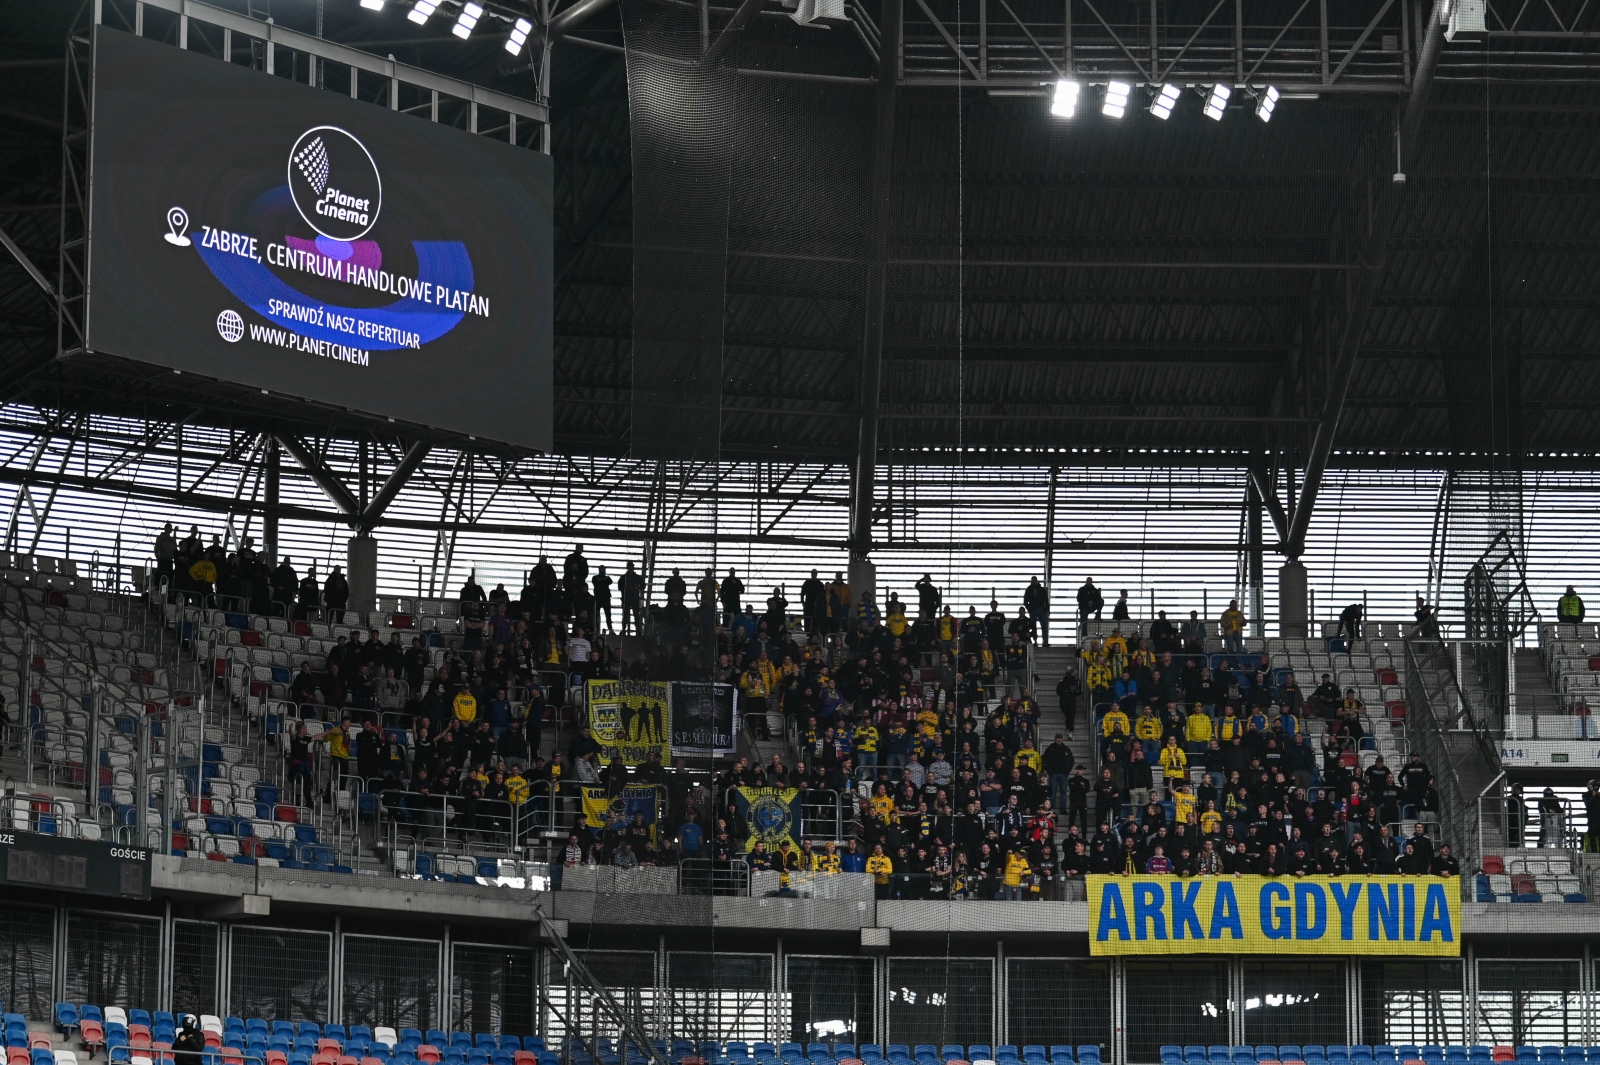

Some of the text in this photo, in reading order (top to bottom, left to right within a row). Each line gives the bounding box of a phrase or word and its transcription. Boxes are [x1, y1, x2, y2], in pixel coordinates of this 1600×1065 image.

[315, 199, 369, 226] Cinema
[325, 187, 370, 212] Planet
[201, 225, 490, 318] ZABRZE, CENTRUM HANDLOWE PLATAN
[268, 298, 421, 350] SPRAWDŹ NASZ REPERTUAR
[250, 323, 369, 367] WWW.PLANETCINEM
[1500, 748, 1524, 759] A14
[588, 789, 609, 800] ARK
[110, 847, 146, 861] GOŚCIE
[1096, 880, 1454, 943] ARKA GDYNIA
